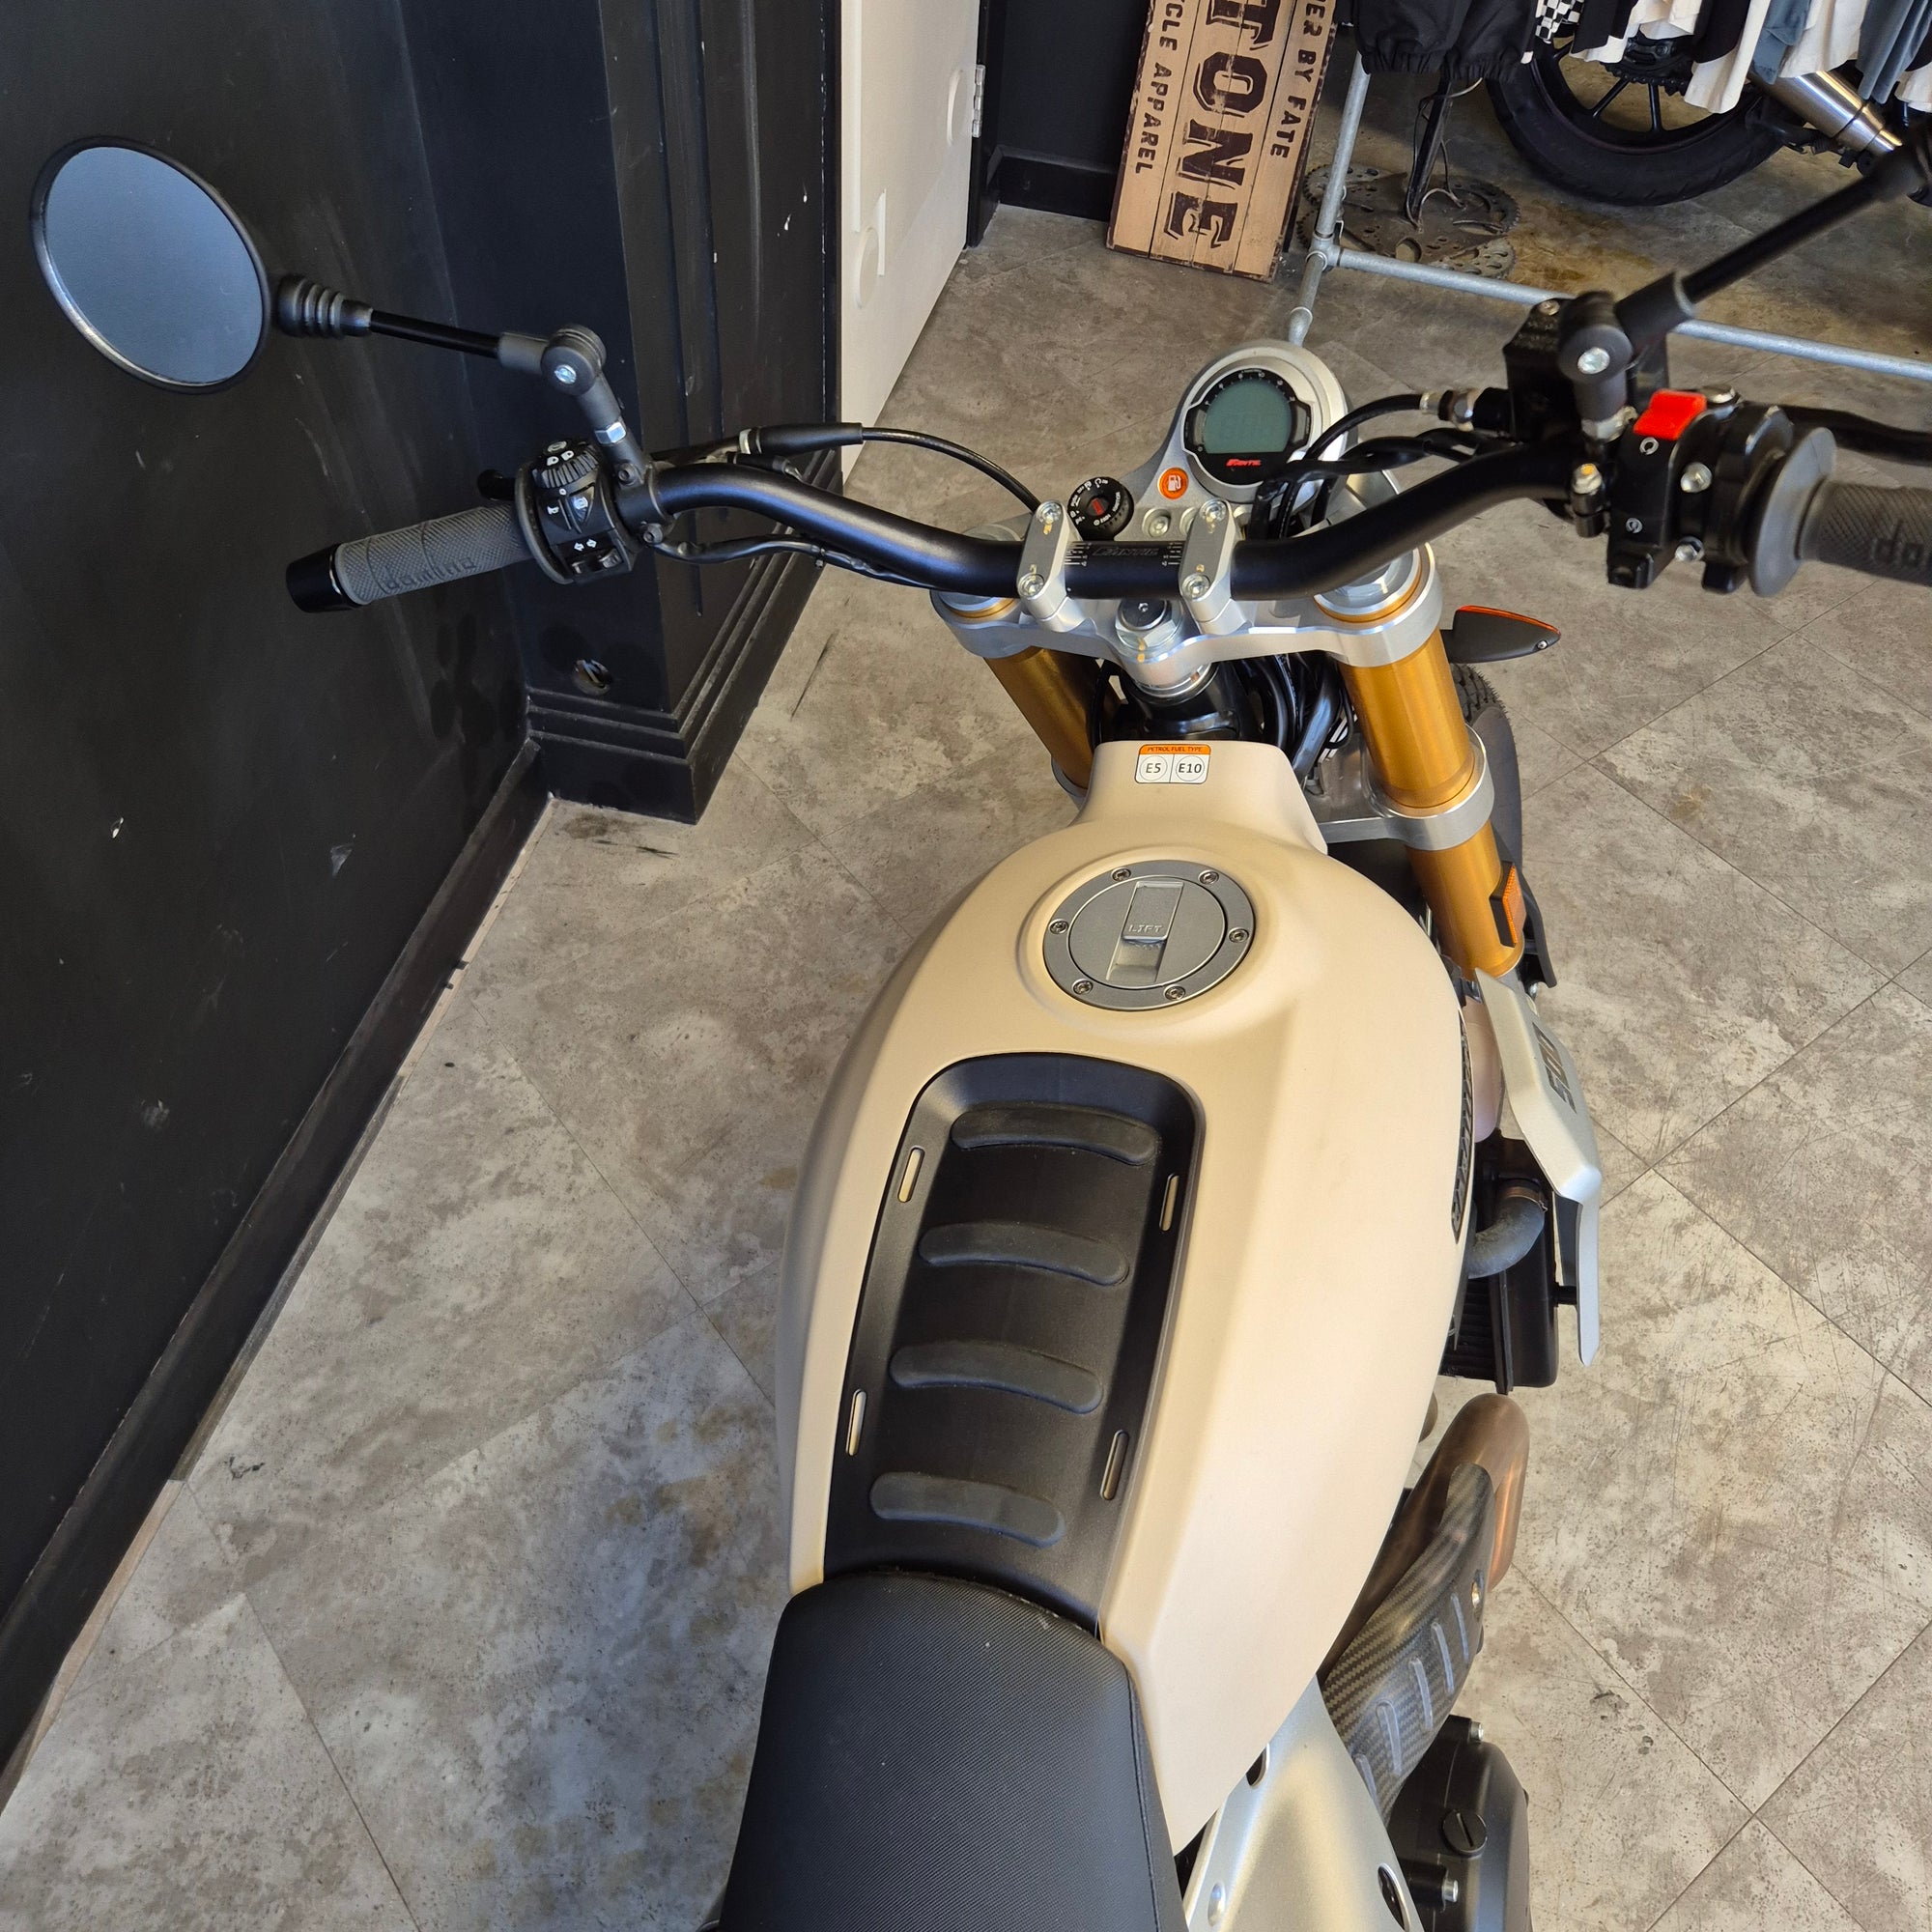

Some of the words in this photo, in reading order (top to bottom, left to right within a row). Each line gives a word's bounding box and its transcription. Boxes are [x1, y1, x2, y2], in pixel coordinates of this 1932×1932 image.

[1159, 0, 1184, 50] CLE
[1303, 0, 1326, 36] ER
[1294, 49, 1316, 82] BY
[1135, 62, 1172, 174] APPAREL
[1270, 96, 1307, 157] FATE
[1874, 518, 1930, 569] do
[1146, 763, 1161, 774] E5
[1178, 763, 1203, 774] E10
[1128, 923, 1164, 933] LIFT
